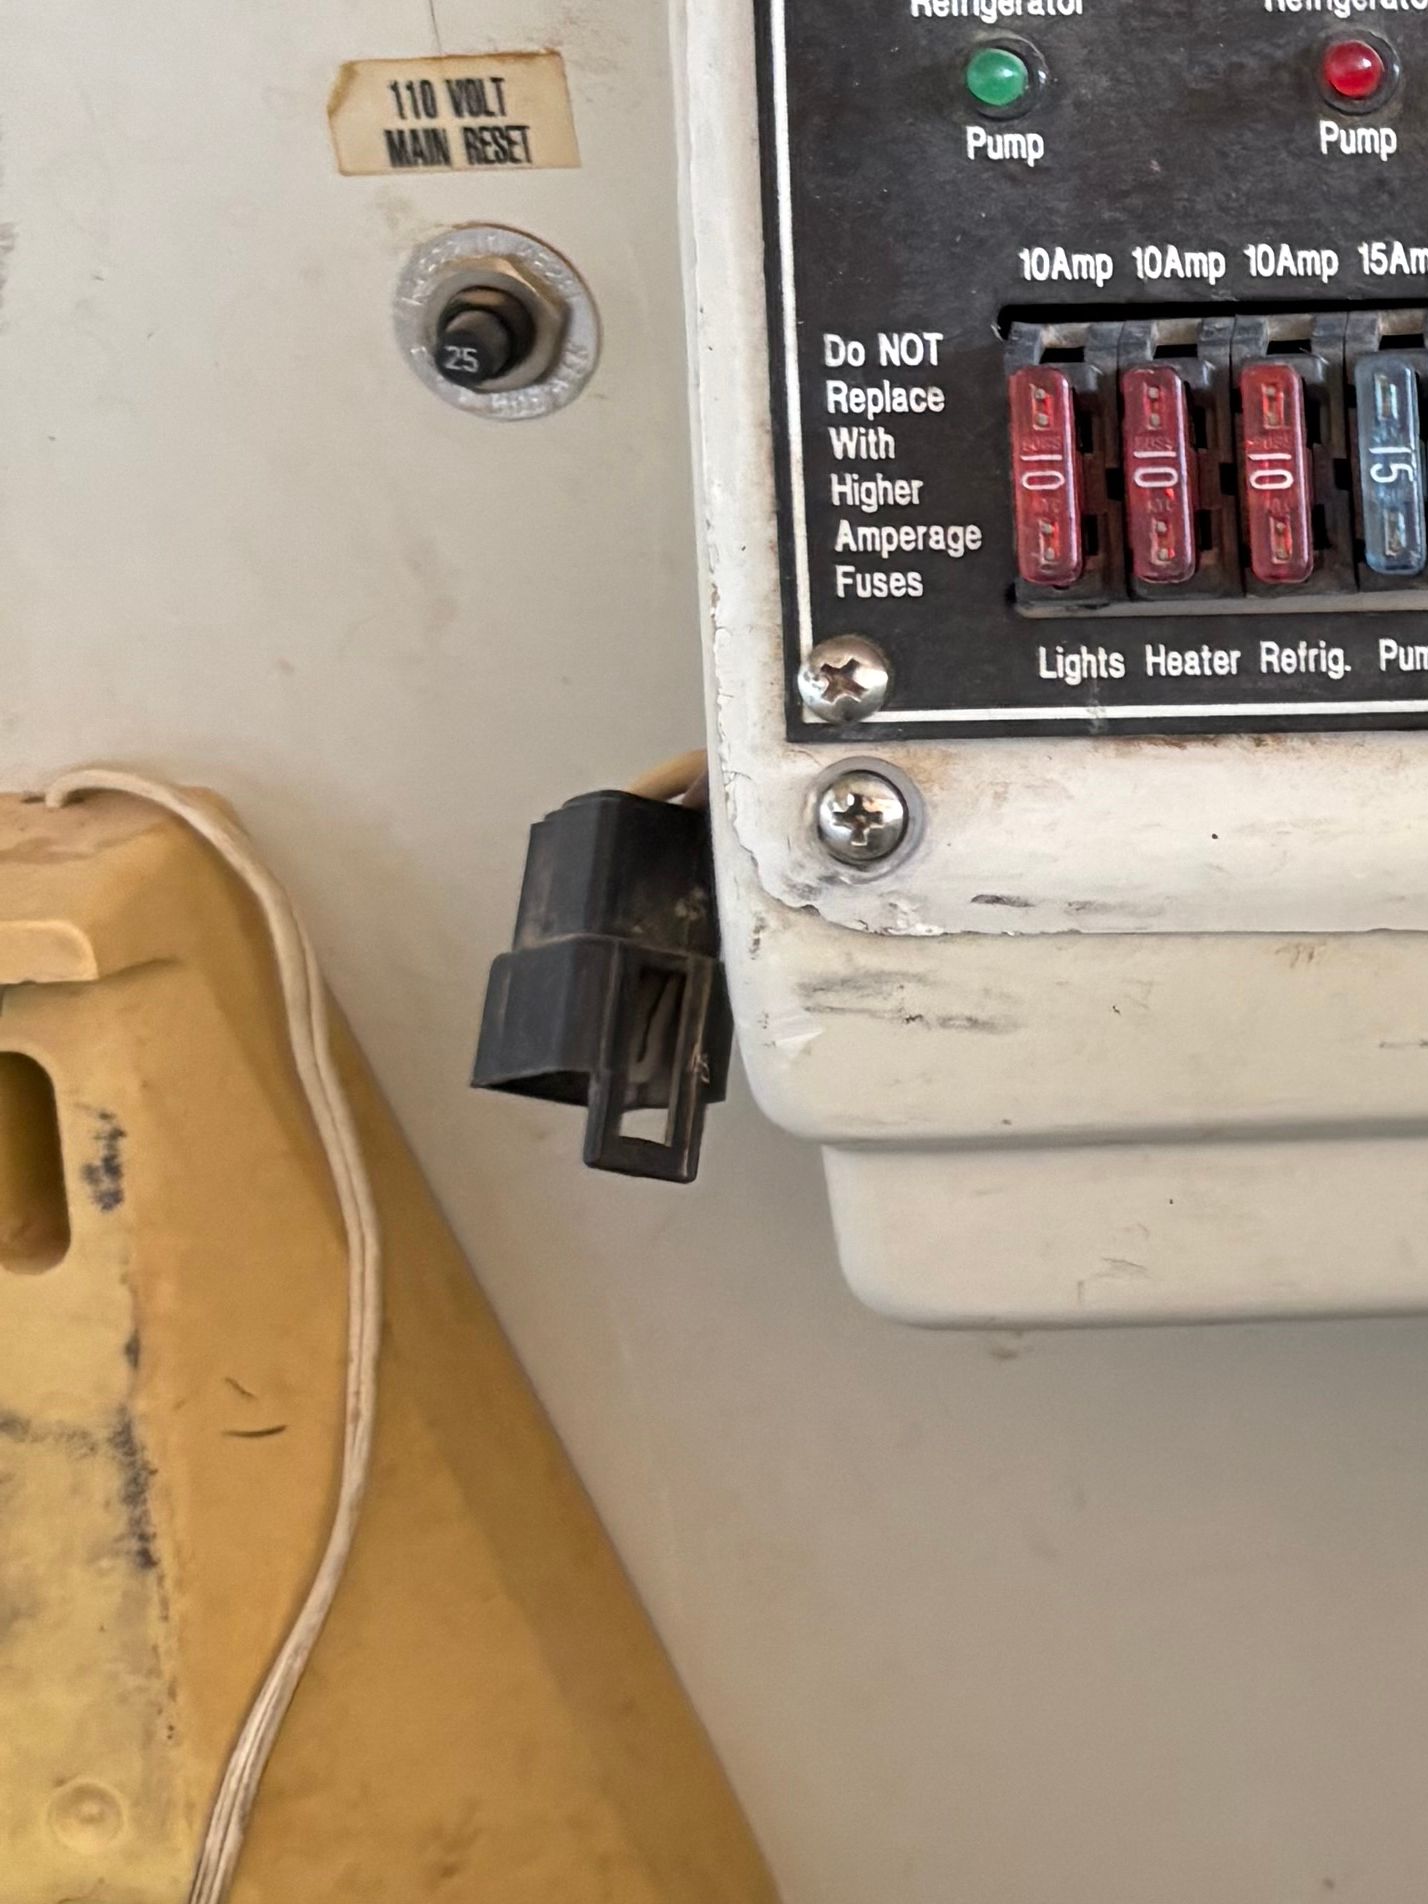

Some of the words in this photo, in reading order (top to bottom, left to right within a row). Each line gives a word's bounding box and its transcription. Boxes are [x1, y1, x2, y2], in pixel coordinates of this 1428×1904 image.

[388, 79, 438, 119] 110
[444, 77, 508, 117] VOLT
[384, 127, 452, 167] MAIN
[462, 125, 533, 165] RESET
[965, 125, 1045, 168] Pump
[1319, 119, 1398, 162] Pump
[1018, 246, 1114, 288] 10Amp
[1131, 244, 1226, 286] 10Amp
[1243, 243, 1340, 284] 10Amp
[443, 345, 480, 374] 25
[823, 333, 866, 367] Do
[877, 331, 944, 367] NOT
[825, 379, 945, 421] Replace
[827, 426, 896, 460] With
[1020, 454, 1065, 490] 10
[1133, 451, 1179, 488] 10
[1248, 453, 1295, 490] 10
[1369, 447, 1416, 484] 15
[830, 472, 924, 514] Higher
[834, 519, 982, 559] Amperage
[835, 564, 924, 598] Fuses
[1038, 645, 1126, 686] Lights
[1145, 643, 1242, 677] Heater
[1259, 640, 1352, 680] Refrig.
